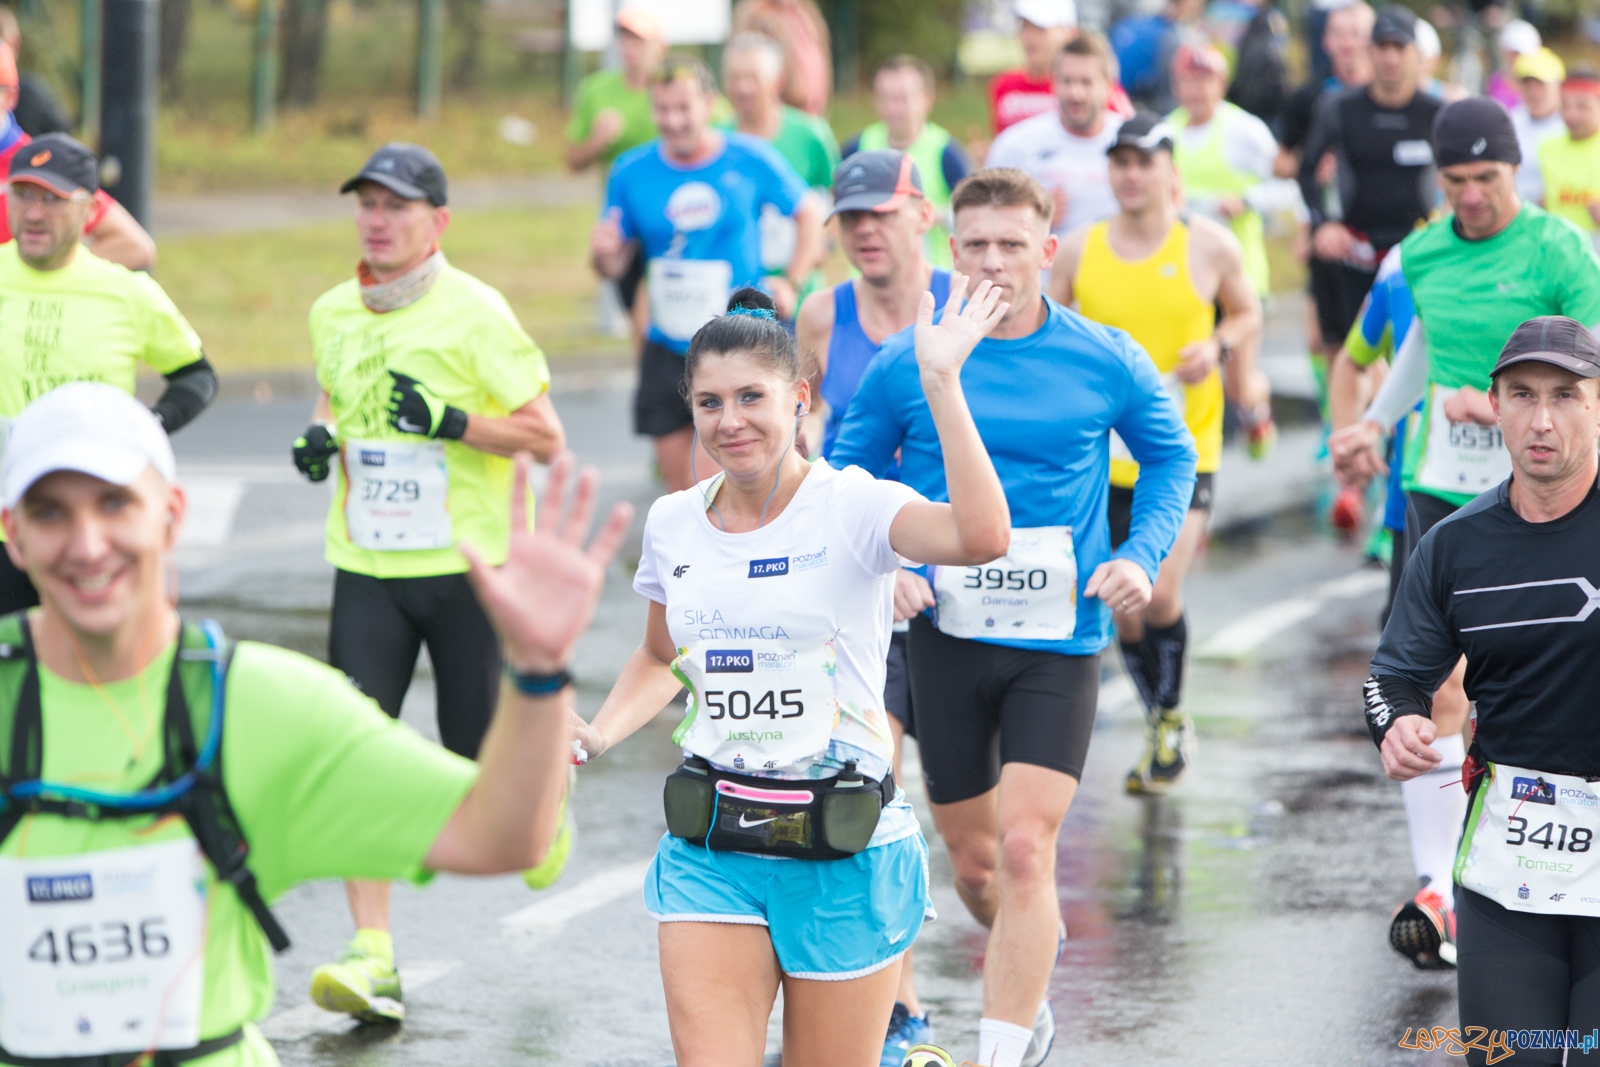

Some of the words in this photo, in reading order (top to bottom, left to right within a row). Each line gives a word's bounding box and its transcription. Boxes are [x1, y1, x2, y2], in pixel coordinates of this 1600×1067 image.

[1449, 421, 1502, 451] 6531
[361, 477, 420, 503] 3729
[673, 565, 690, 578] 4F
[964, 566, 1047, 591] 3950
[982, 596, 1028, 607] Damian
[684, 609, 725, 625] SIŁA
[699, 625, 790, 640] ODWAGA
[758, 660, 797, 669] maraton
[705, 689, 804, 720] 5045
[726, 730, 783, 743] Justyna
[1560, 797, 1598, 808] maraton
[1506, 816, 1593, 853] 3418
[1516, 855, 1573, 873] Tomasz
[1549, 893, 1567, 902] 4F
[28, 916, 171, 966] 4636
